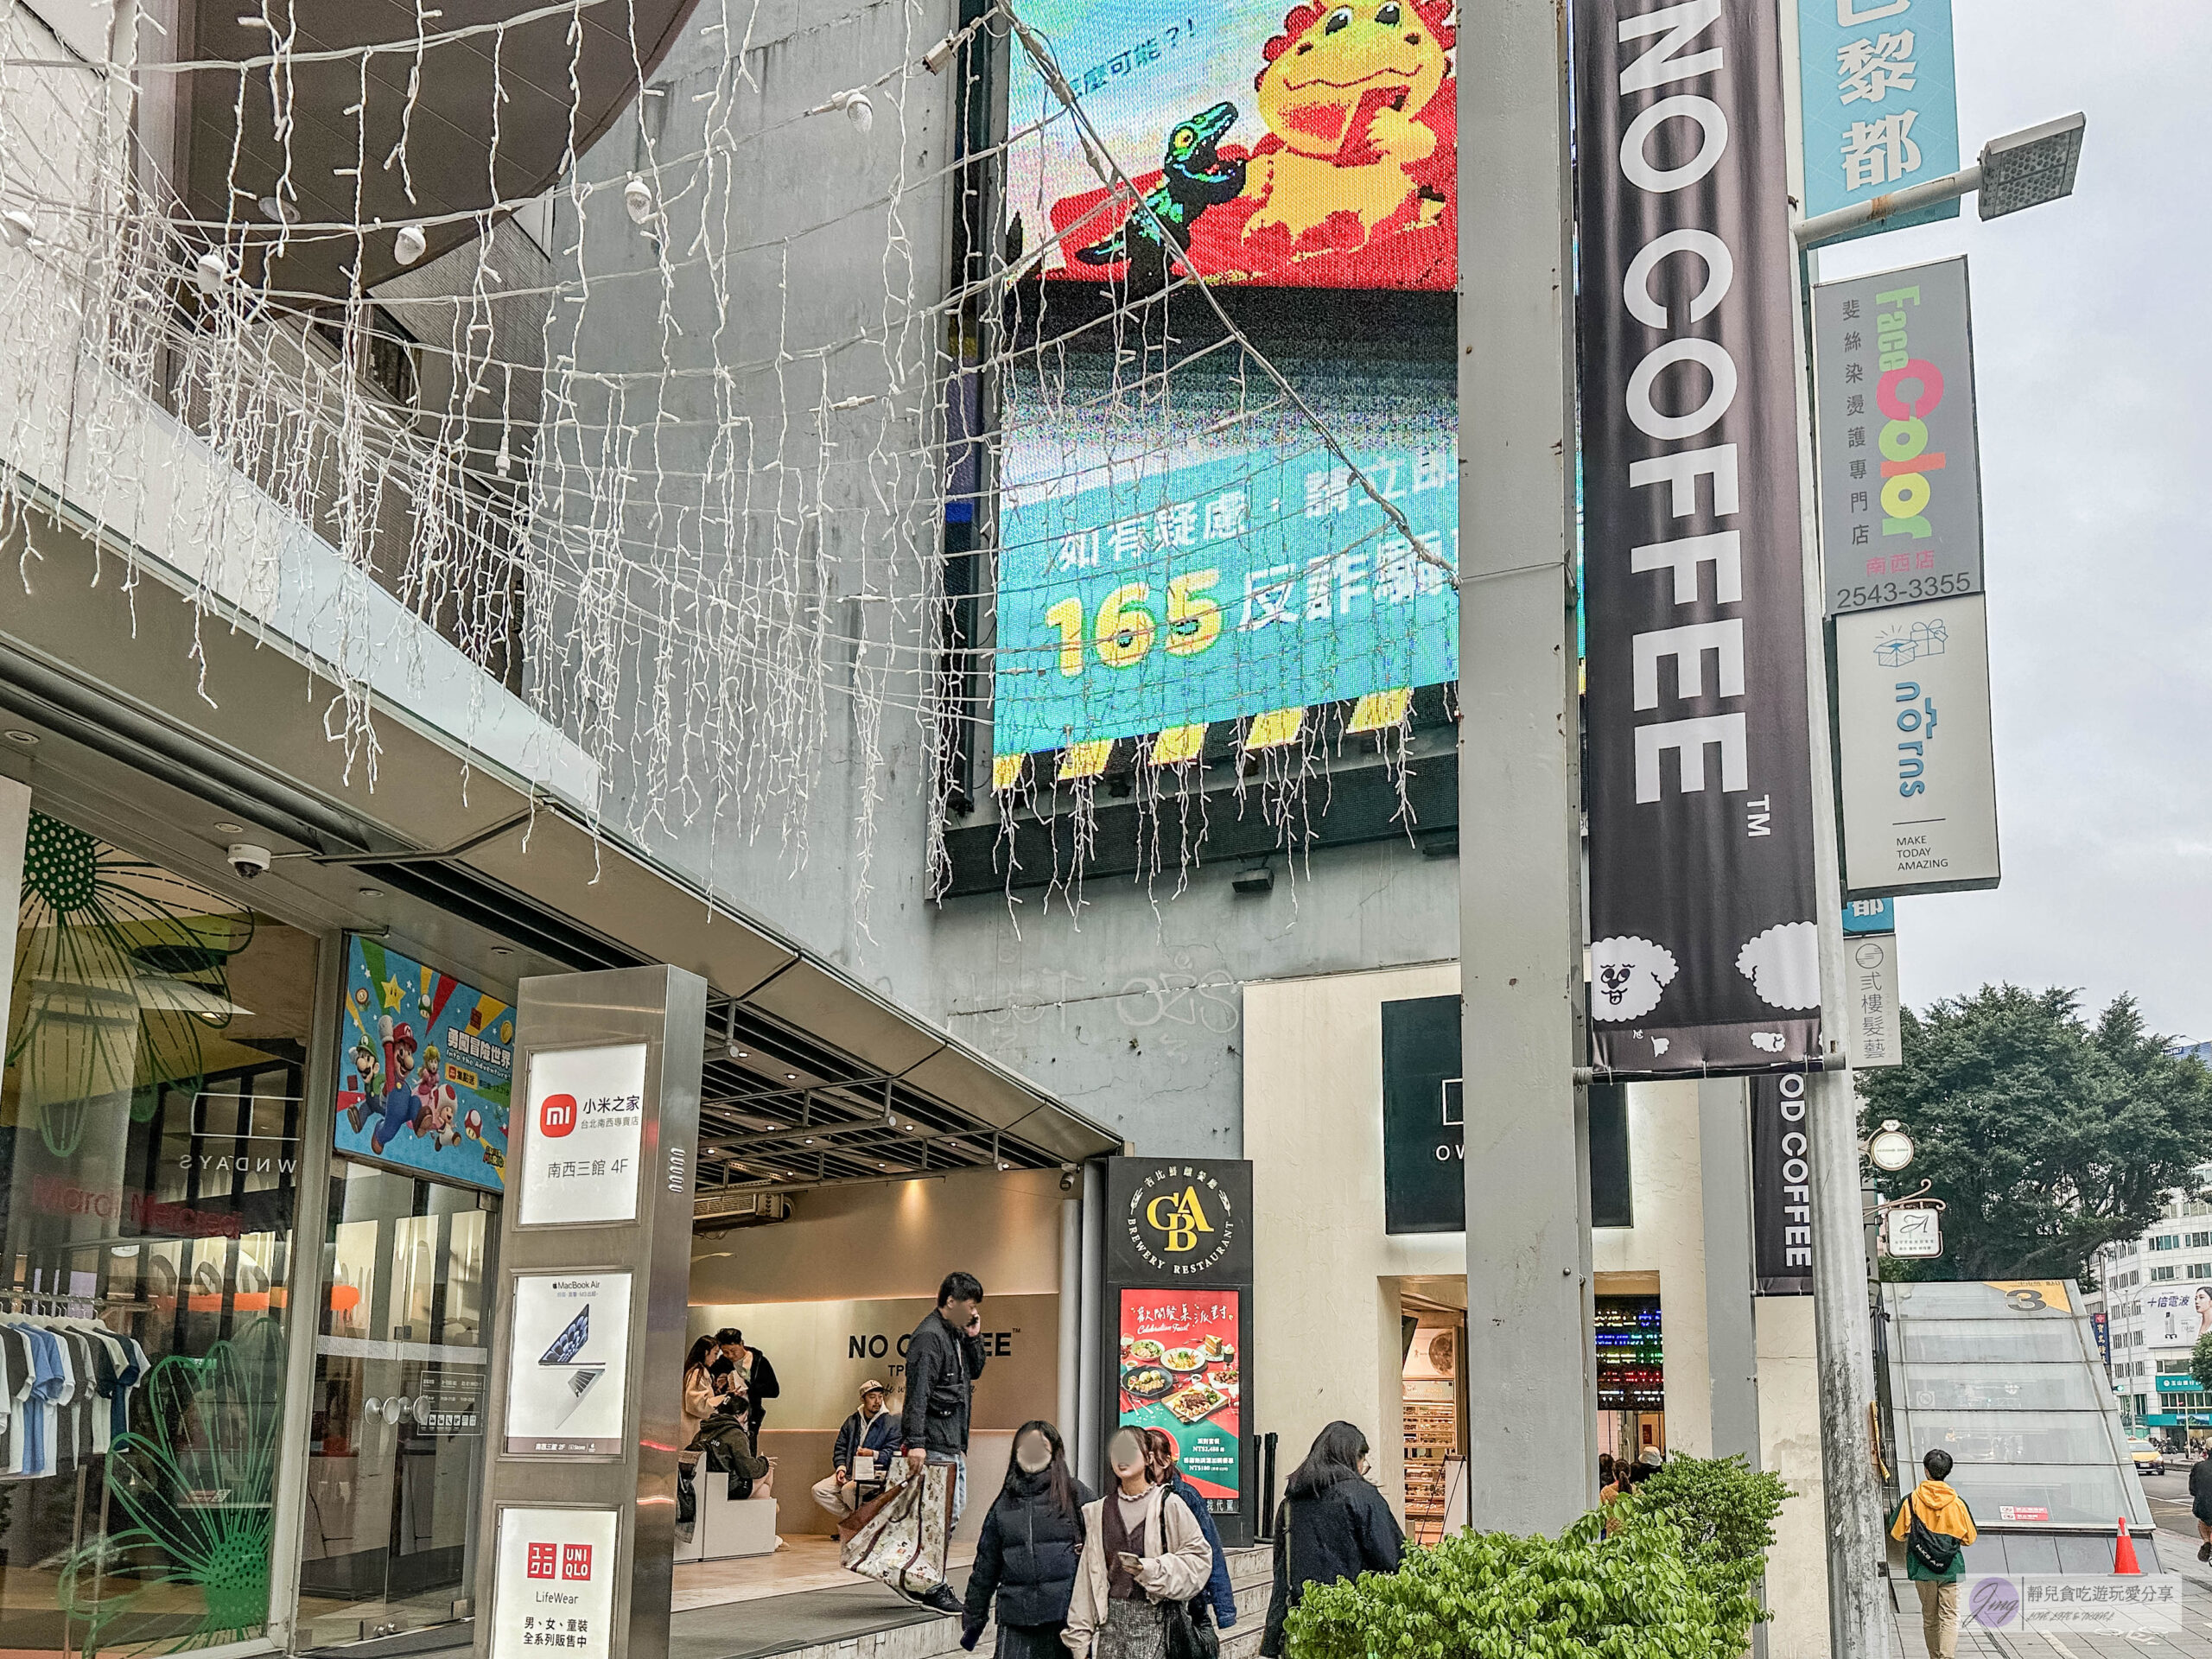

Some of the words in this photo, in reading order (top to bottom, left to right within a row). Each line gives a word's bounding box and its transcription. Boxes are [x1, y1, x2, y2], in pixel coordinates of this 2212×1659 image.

[1619, 0, 1729, 194] NO
[1876, 284, 1920, 372] Face
[1841, 299, 1870, 546] 斐絲染燙護專門店
[1876, 359, 1946, 539] Color
[1624, 229, 1749, 804] COFFEE
[1866, 550, 1935, 577] 南西店
[1837, 571, 1971, 609] 2543-3355
[1044, 569, 1224, 677] 165
[1895, 681, 1925, 798] norns
[1896, 835, 1927, 846] MAKE
[1897, 847, 1931, 858] TODAY
[1897, 858, 1948, 871] AMAZING
[447, 1049, 461, 1061] Into
[462, 1056, 474, 1066] the
[475, 1060, 511, 1080] Adventure!
[583, 1095, 639, 1114] 小米之家
[582, 1116, 639, 1129] 台北南西專賣店
[484, 1153, 505, 1167] MARIO
[548, 1160, 606, 1179] 南西三館
[611, 1159, 628, 1174] 4F
[1781, 1132, 1811, 1267] COFFEE
[1128, 1217, 1166, 1269] BREWERY
[1173, 1221, 1234, 1274] RESTAURANT
[2006, 1289, 2047, 1312] 3
[2147, 1295, 2190, 1308] 十倍電波
[849, 1333, 888, 1359] NO
[888, 1365, 907, 1376] TP
[531, 1547, 552, 1560] ユニ
[566, 1548, 587, 1561] UNI
[531, 1561, 552, 1574] クロ
[565, 1563, 588, 1578] QLO
[536, 1591, 579, 1604] LifeWear
[524, 1617, 588, 1632] 男、女、童裝
[524, 1632, 587, 1648] 全系列販售中
